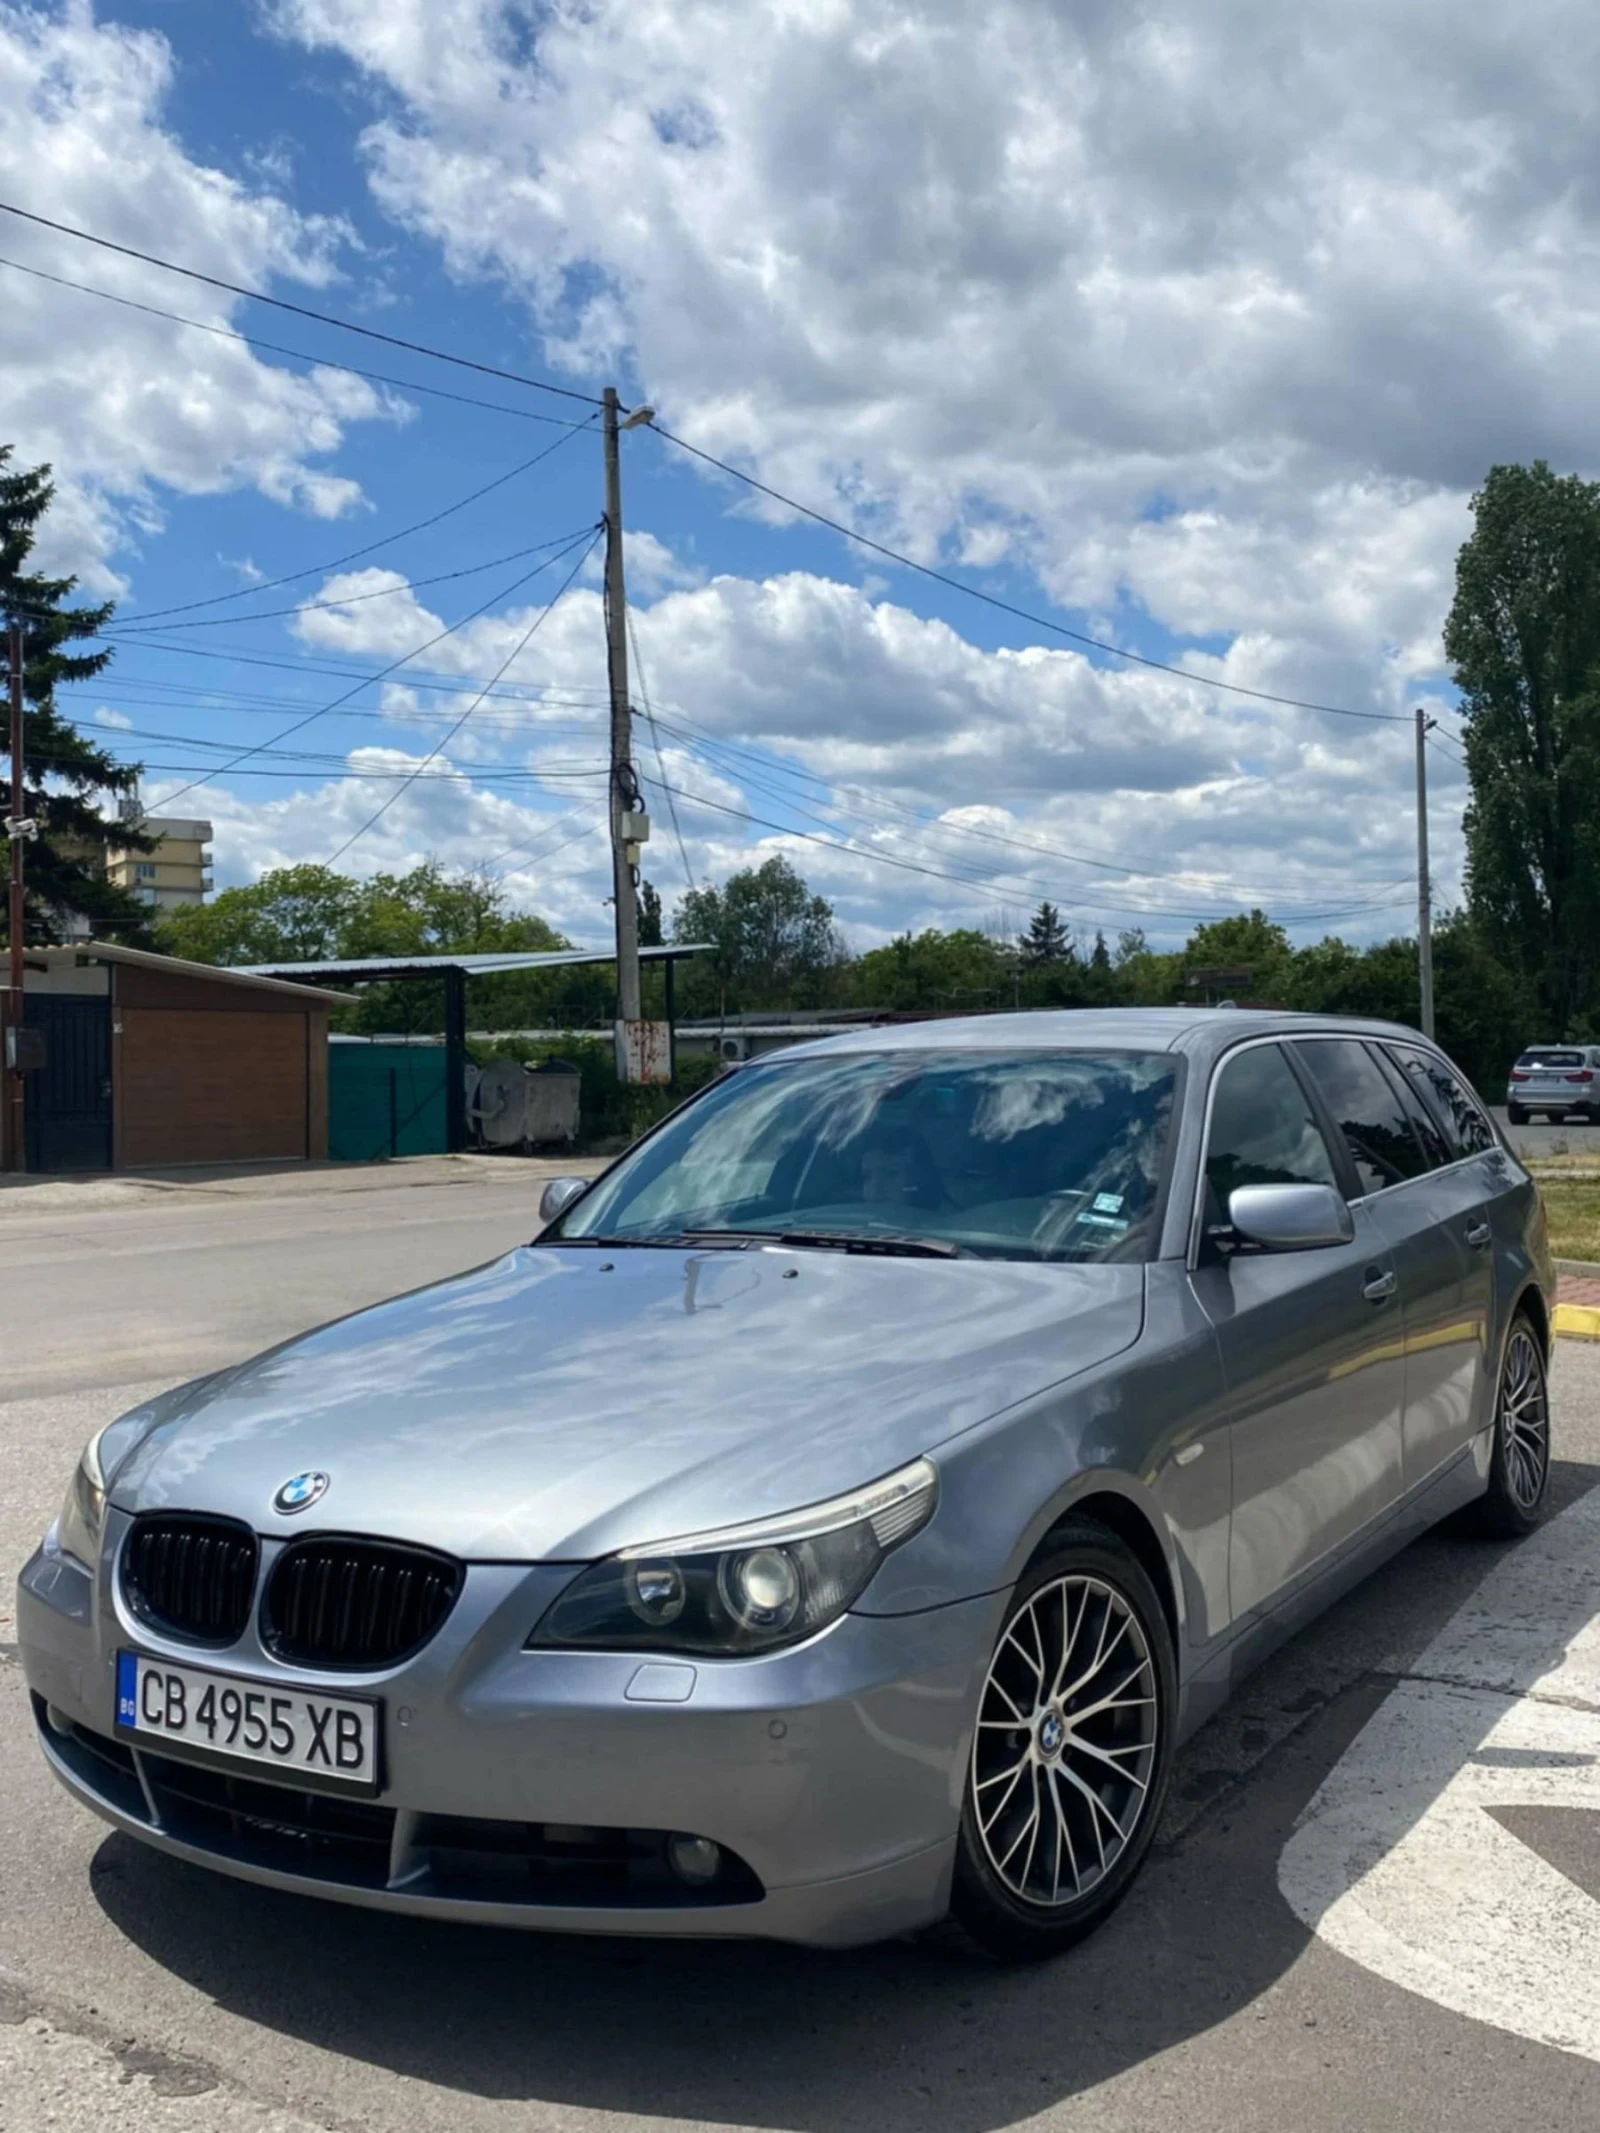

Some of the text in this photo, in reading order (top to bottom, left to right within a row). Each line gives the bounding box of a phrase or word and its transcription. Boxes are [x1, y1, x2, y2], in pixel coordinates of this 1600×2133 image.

[120, 1698, 135, 1716] BG
[142, 1670, 365, 1769] CB 4955 XB
